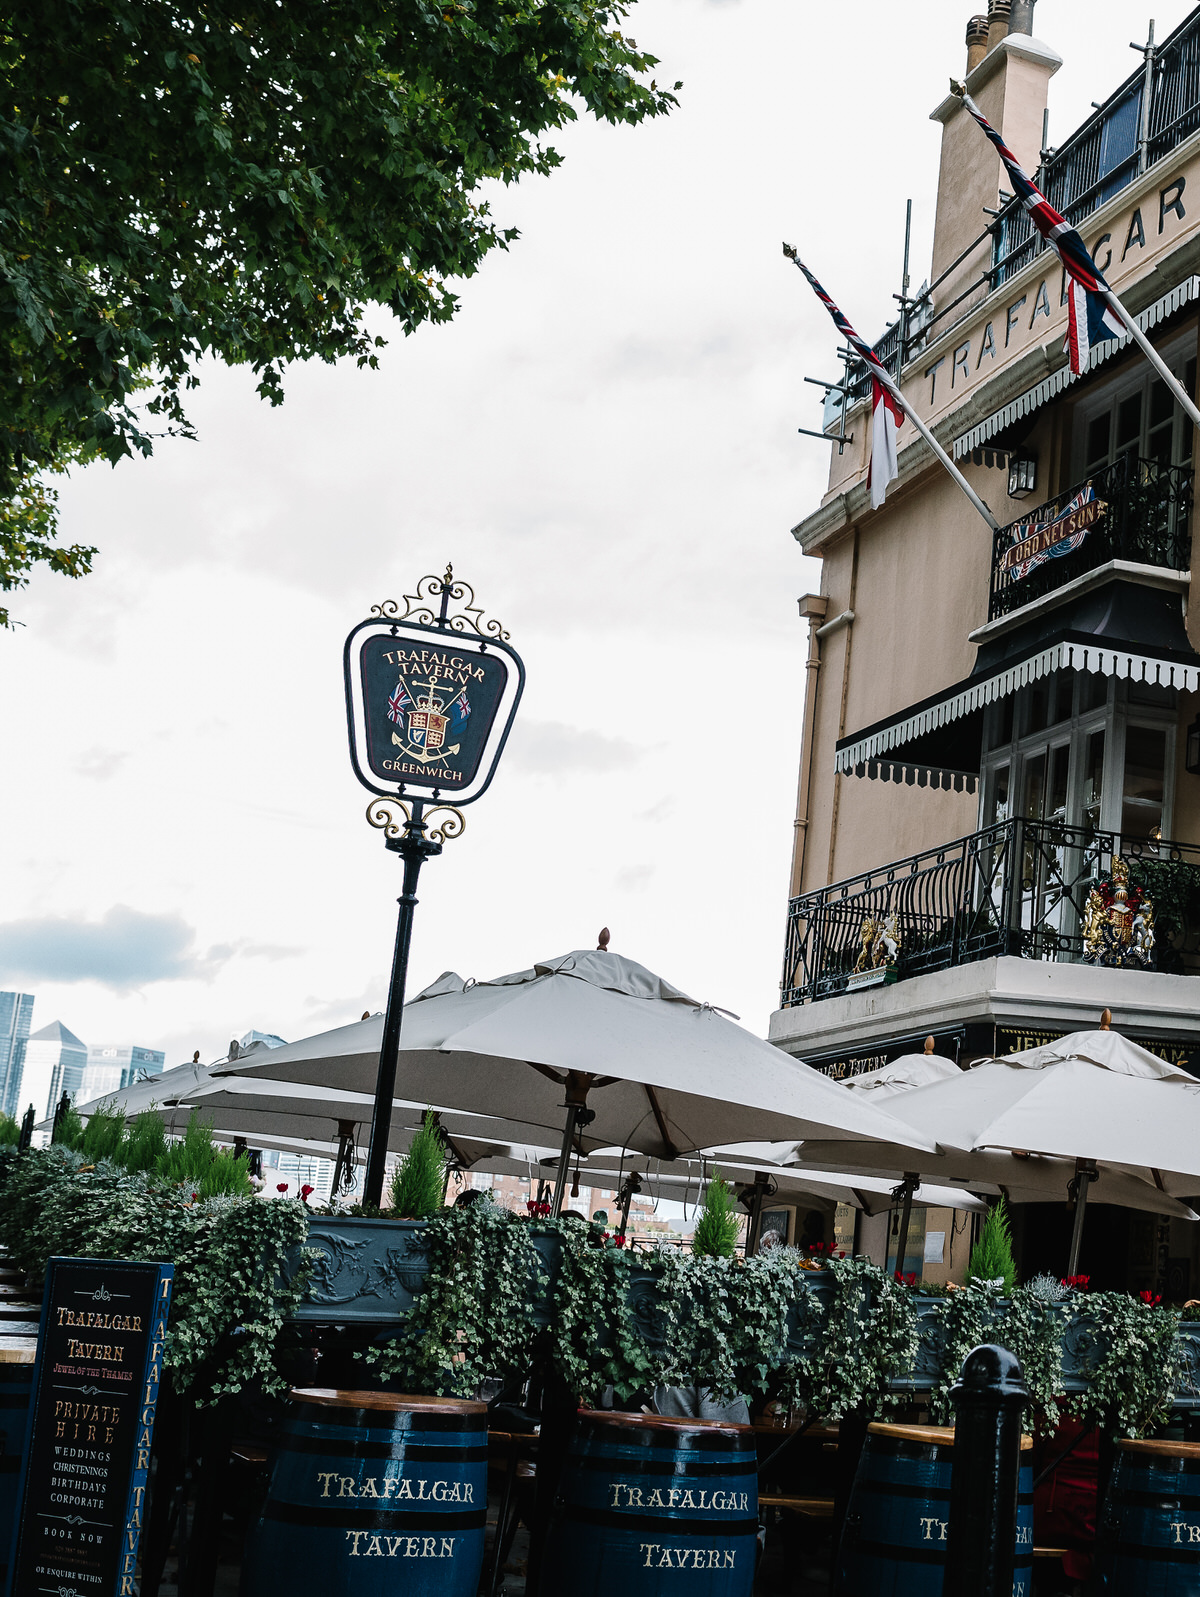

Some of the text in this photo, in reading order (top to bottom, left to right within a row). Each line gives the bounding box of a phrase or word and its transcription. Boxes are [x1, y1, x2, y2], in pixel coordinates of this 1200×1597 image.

[1007, 536, 1040, 567] LORD
[383, 650, 485, 684] TRAFALGAR
[397, 662, 470, 685] TAVERN
[382, 759, 463, 781] GREENWICH
[57, 1307, 142, 1332] TRAFALGAR
[67, 1339, 125, 1362] TAVERN
[53, 1363, 76, 1375] JEWEL
[86, 1367, 100, 1377] THE
[101, 1368, 133, 1381] THAMES
[54, 1400, 120, 1424] PRIVATE
[55, 1421, 114, 1444] HIRE
[120, 1278, 172, 1596] TRAFALGAR TAVER
[54, 1446, 111, 1462] WEDDINGS
[53, 1461, 109, 1478] CHRISTENINGS
[51, 1477, 107, 1493] BIRTHDAYS
[317, 1472, 475, 1503] TRAFALGAR
[50, 1493, 104, 1509] CORPORATE
[608, 1483, 749, 1512] TRAFALGAR
[44, 1527, 104, 1544] BOOK NOW
[345, 1531, 456, 1558] TAVERN
[639, 1543, 737, 1569] TAVERN
[36, 1566, 103, 1584] OR ENQUIRE WITHIN
